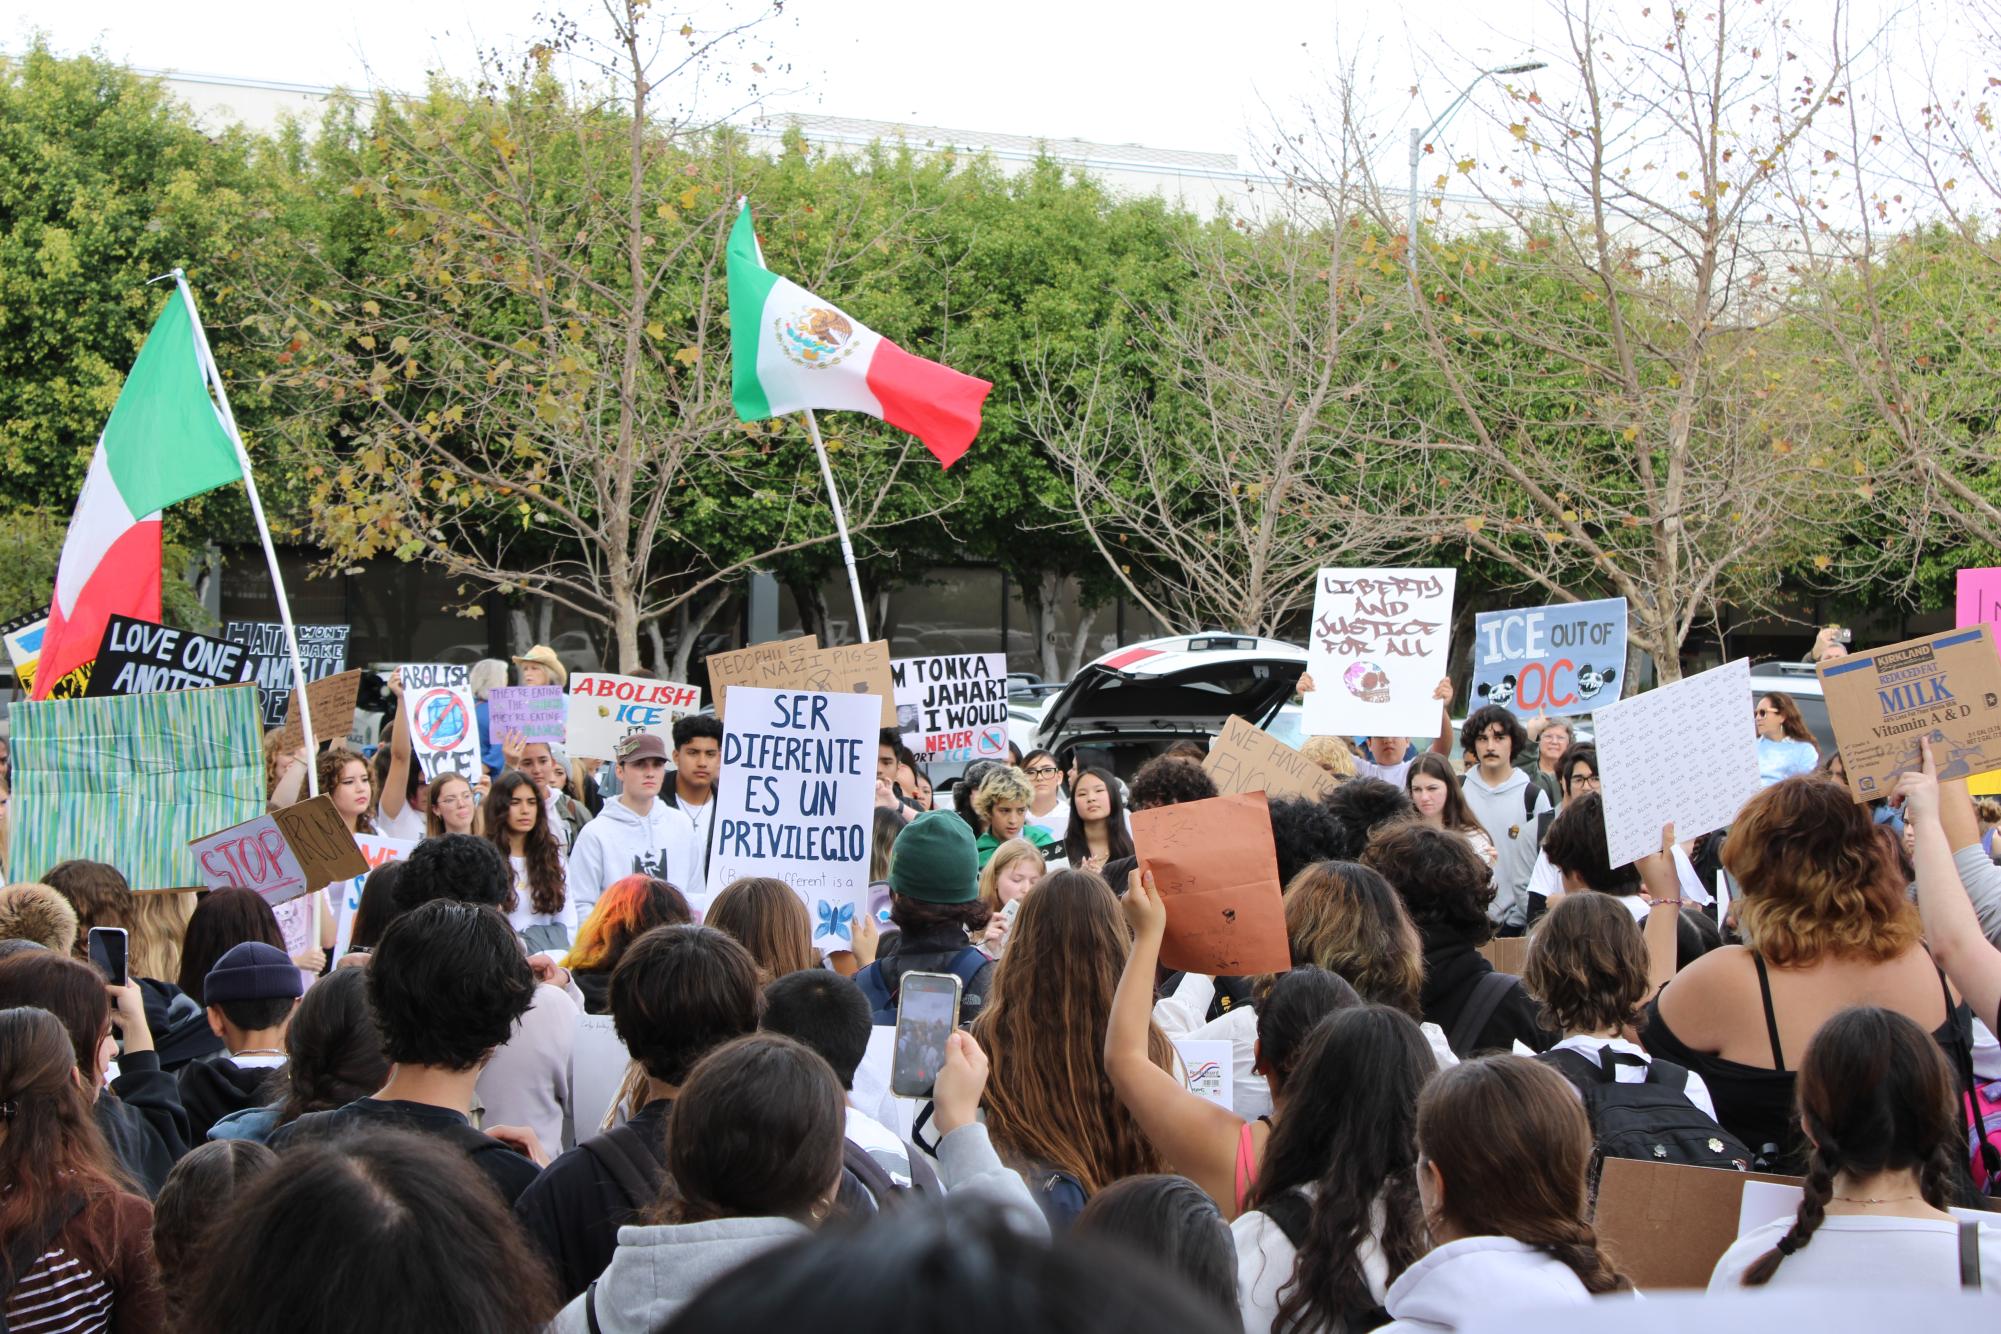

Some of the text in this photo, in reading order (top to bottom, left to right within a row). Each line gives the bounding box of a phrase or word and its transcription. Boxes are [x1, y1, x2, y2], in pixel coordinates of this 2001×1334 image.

[1325, 575, 1443, 599] LIBERTY
[1354, 596, 1409, 618] AND
[1315, 611, 1443, 640] JUSTICE
[1481, 612, 1615, 665] I.C.E. OUT OF
[110, 622, 242, 680] LOVE ONE
[299, 644, 344, 659] MAKE
[1321, 636, 1433, 657] FOR ALL
[1877, 645, 1931, 667] KIRKLAND
[403, 666, 470, 690] ABOLISH
[762, 655, 822, 680] NAZI
[833, 648, 879, 664] PIGS
[913, 656, 990, 683] TONKA
[1879, 667, 1921, 685] REDUCED
[1921, 662, 1938, 675] FAT
[572, 678, 696, 707] ABOLISH
[922, 679, 1007, 707] JAHARI
[1516, 658, 1579, 711] O.C.
[1878, 675, 1954, 714] MILK
[615, 704, 666, 725] ICE
[771, 694, 830, 732] SER
[924, 703, 1008, 732] I WOULD
[1872, 704, 1971, 739] Vitamin A & D
[723, 732, 863, 775] DIFERENTE
[925, 730, 974, 752] NEVER
[944, 748, 972, 762] ICE
[1230, 721, 1264, 751] WE
[1267, 743, 1311, 778] HAVE
[419, 748, 474, 781] ICE
[745, 775, 838, 816] ES UN
[719, 819, 865, 862] PRIVILEGIO
[201, 827, 285, 888] STOP
[778, 872, 854, 888] fferent is a
